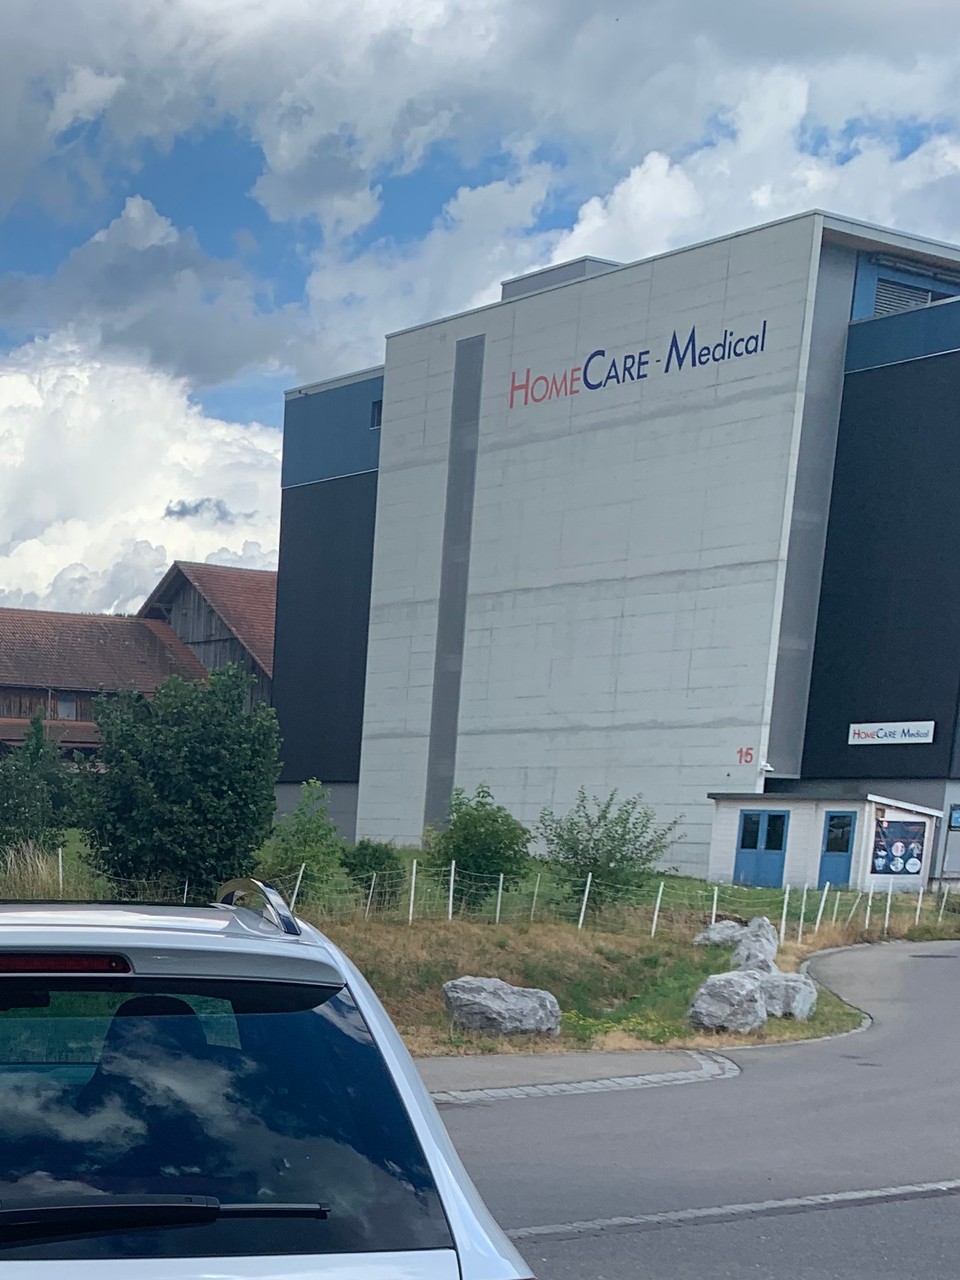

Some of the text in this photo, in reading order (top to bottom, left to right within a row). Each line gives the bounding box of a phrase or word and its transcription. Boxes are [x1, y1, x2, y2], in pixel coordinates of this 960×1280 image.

[664, 320, 767, 374] Medical
[901, 728, 930, 739] Medical
[736, 747, 754, 764] 15
